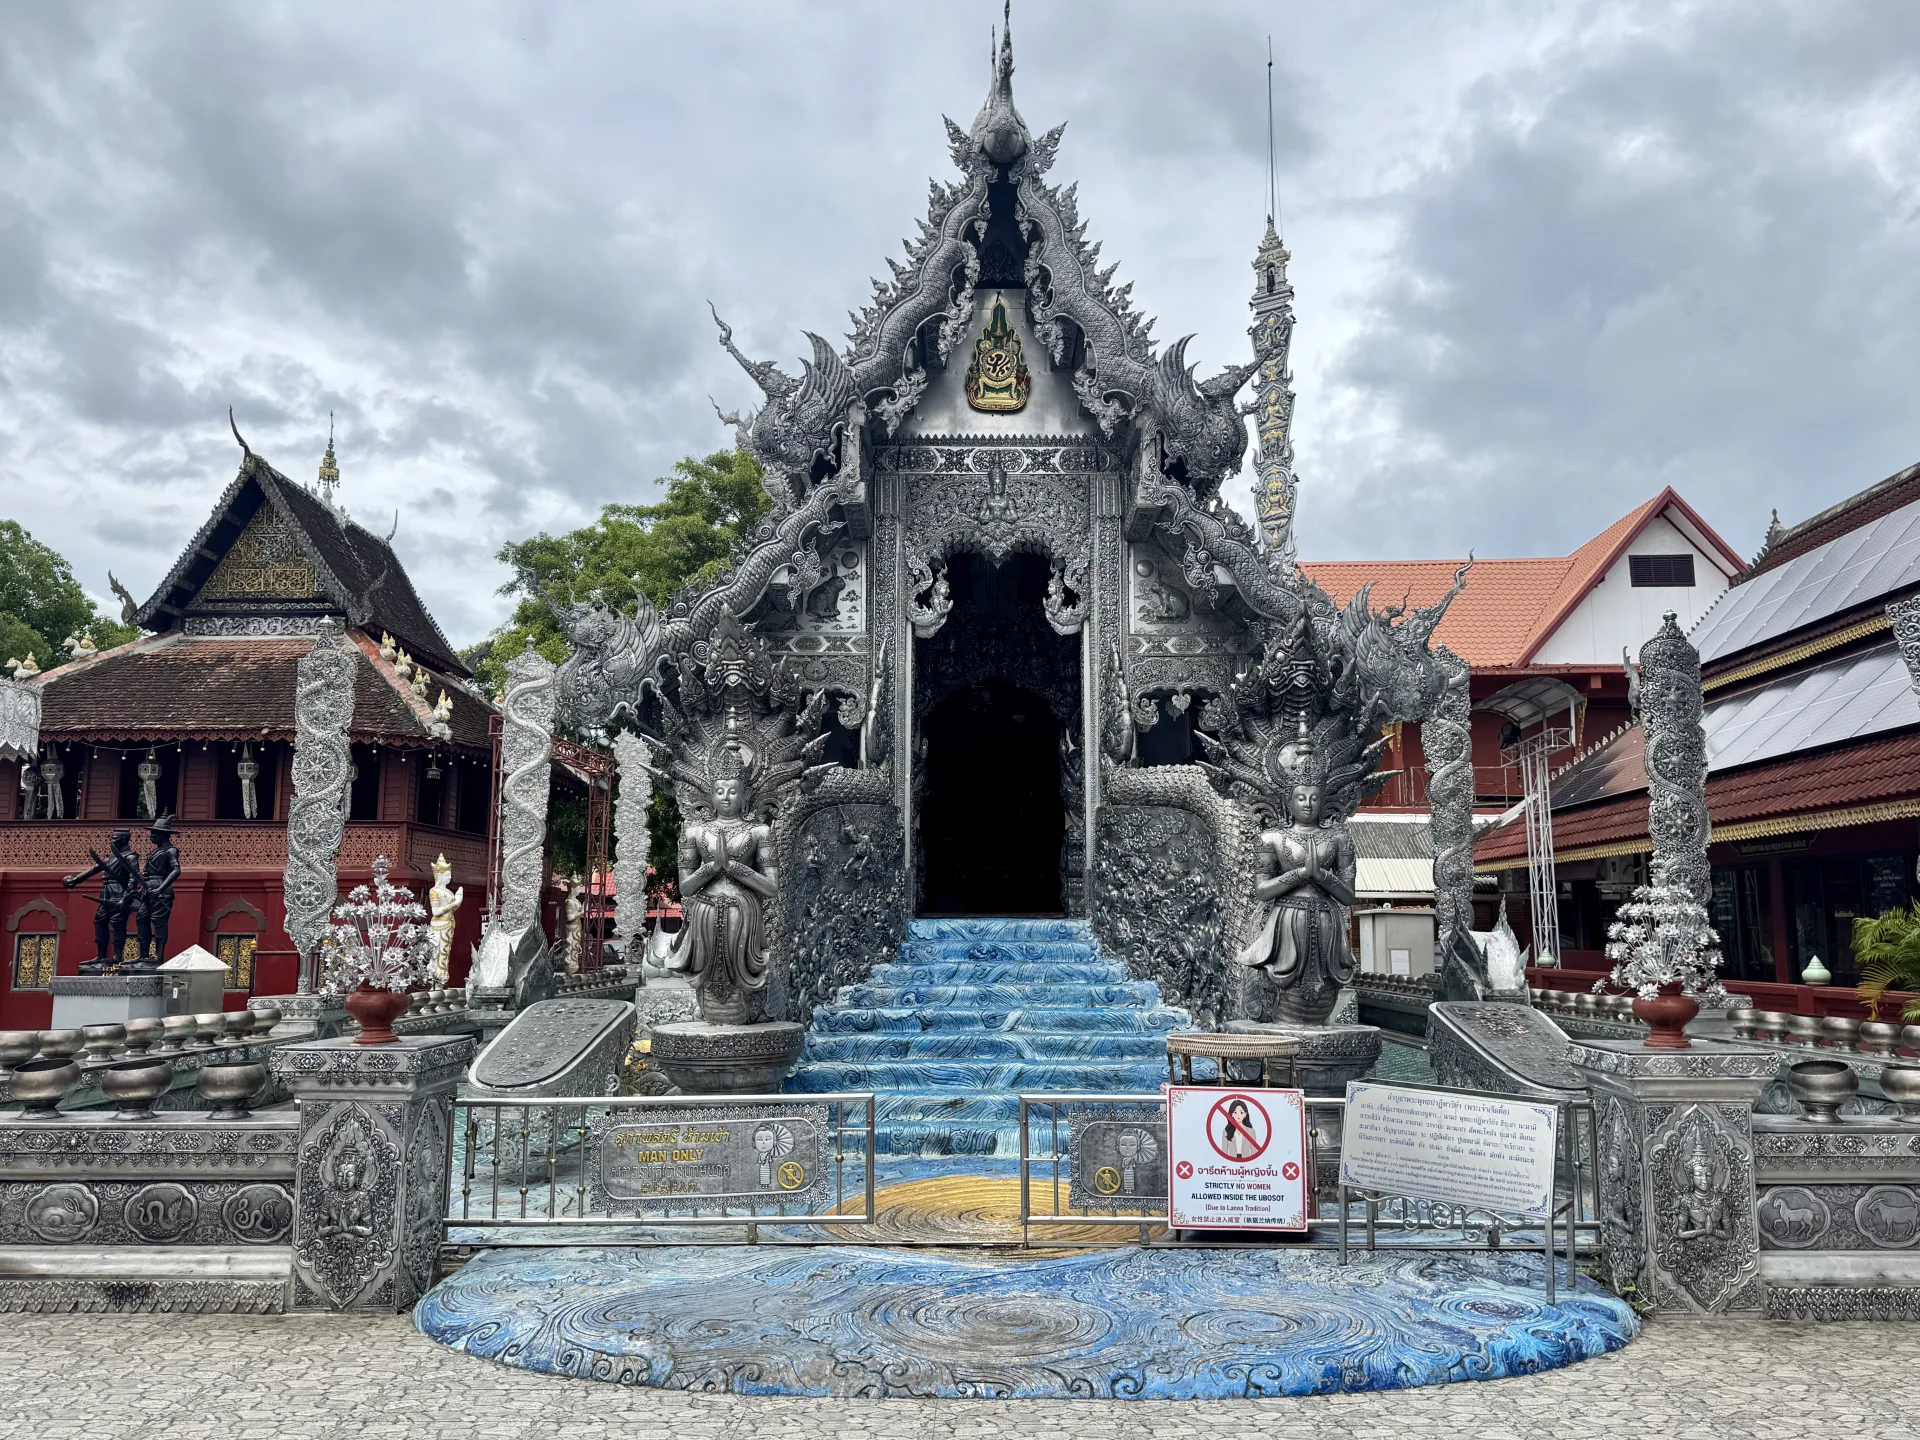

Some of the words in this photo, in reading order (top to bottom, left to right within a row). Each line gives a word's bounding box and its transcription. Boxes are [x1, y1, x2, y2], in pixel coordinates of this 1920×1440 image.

[615, 1129, 680, 1147] สุภาพสตรี
[682, 1127, 730, 1143] ห้ามเข้า
[638, 1150, 667, 1162] MAN
[672, 1149, 703, 1161] ONLY
[1197, 1164, 1278, 1178] จารีตห้ามผู้หญิงขึ้น
